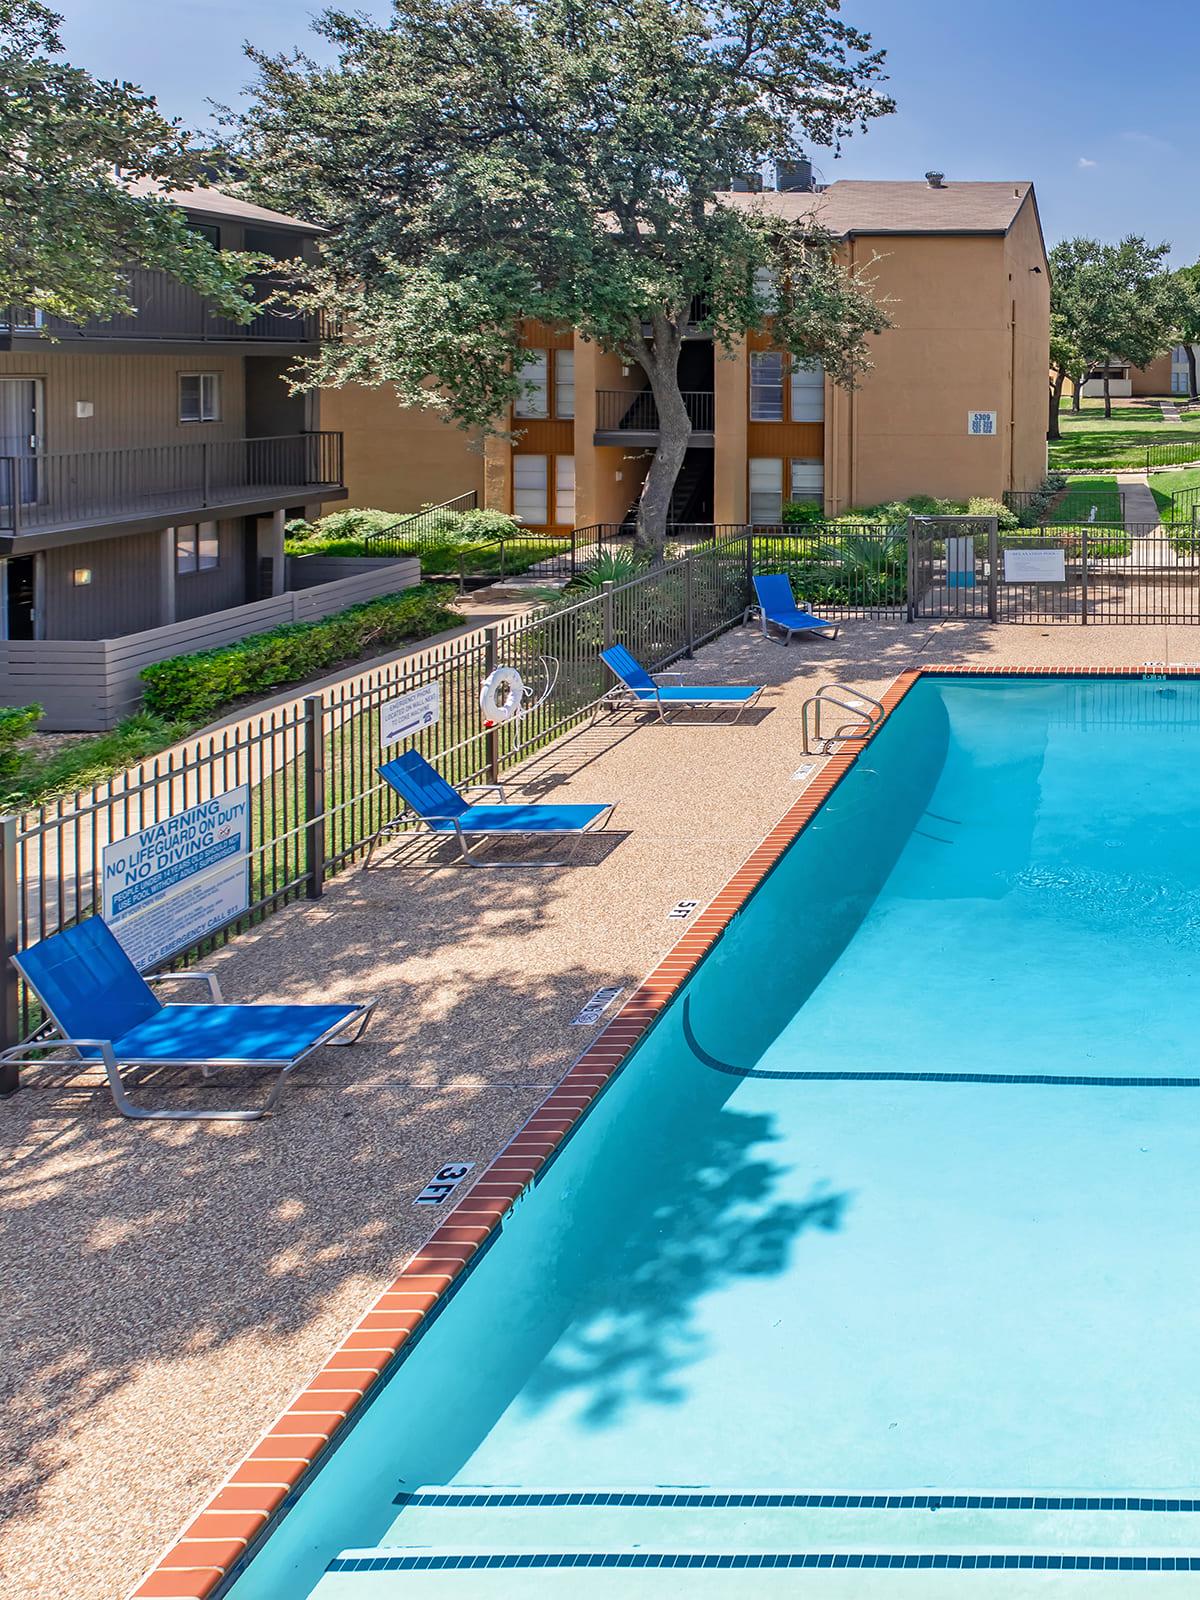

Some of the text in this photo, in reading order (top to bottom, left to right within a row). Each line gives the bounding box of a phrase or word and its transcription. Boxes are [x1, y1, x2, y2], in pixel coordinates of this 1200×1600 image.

[974, 413, 991, 421] 5309
[107, 802, 245, 879] NO LIFEGUARD ON DUTY
[140, 801, 219, 847] WARNING
[114, 885, 139, 903] PEOPLE
[141, 874, 162, 890] UNDER
[192, 853, 204, 865] OLD
[205, 842, 227, 858] SHOULD
[229, 836, 238, 846] NOT
[118, 846, 236, 909] USE POOL WITHOUT ADULT SUPERVISION
[125, 832, 213, 885] NO DIVING
[669, 909, 691, 918] FT
[148, 951, 159, 961] OF
[160, 924, 205, 955] EMERGENCY
[207, 914, 225, 927] CALL
[416, 1167, 467, 1203] 3 FT
